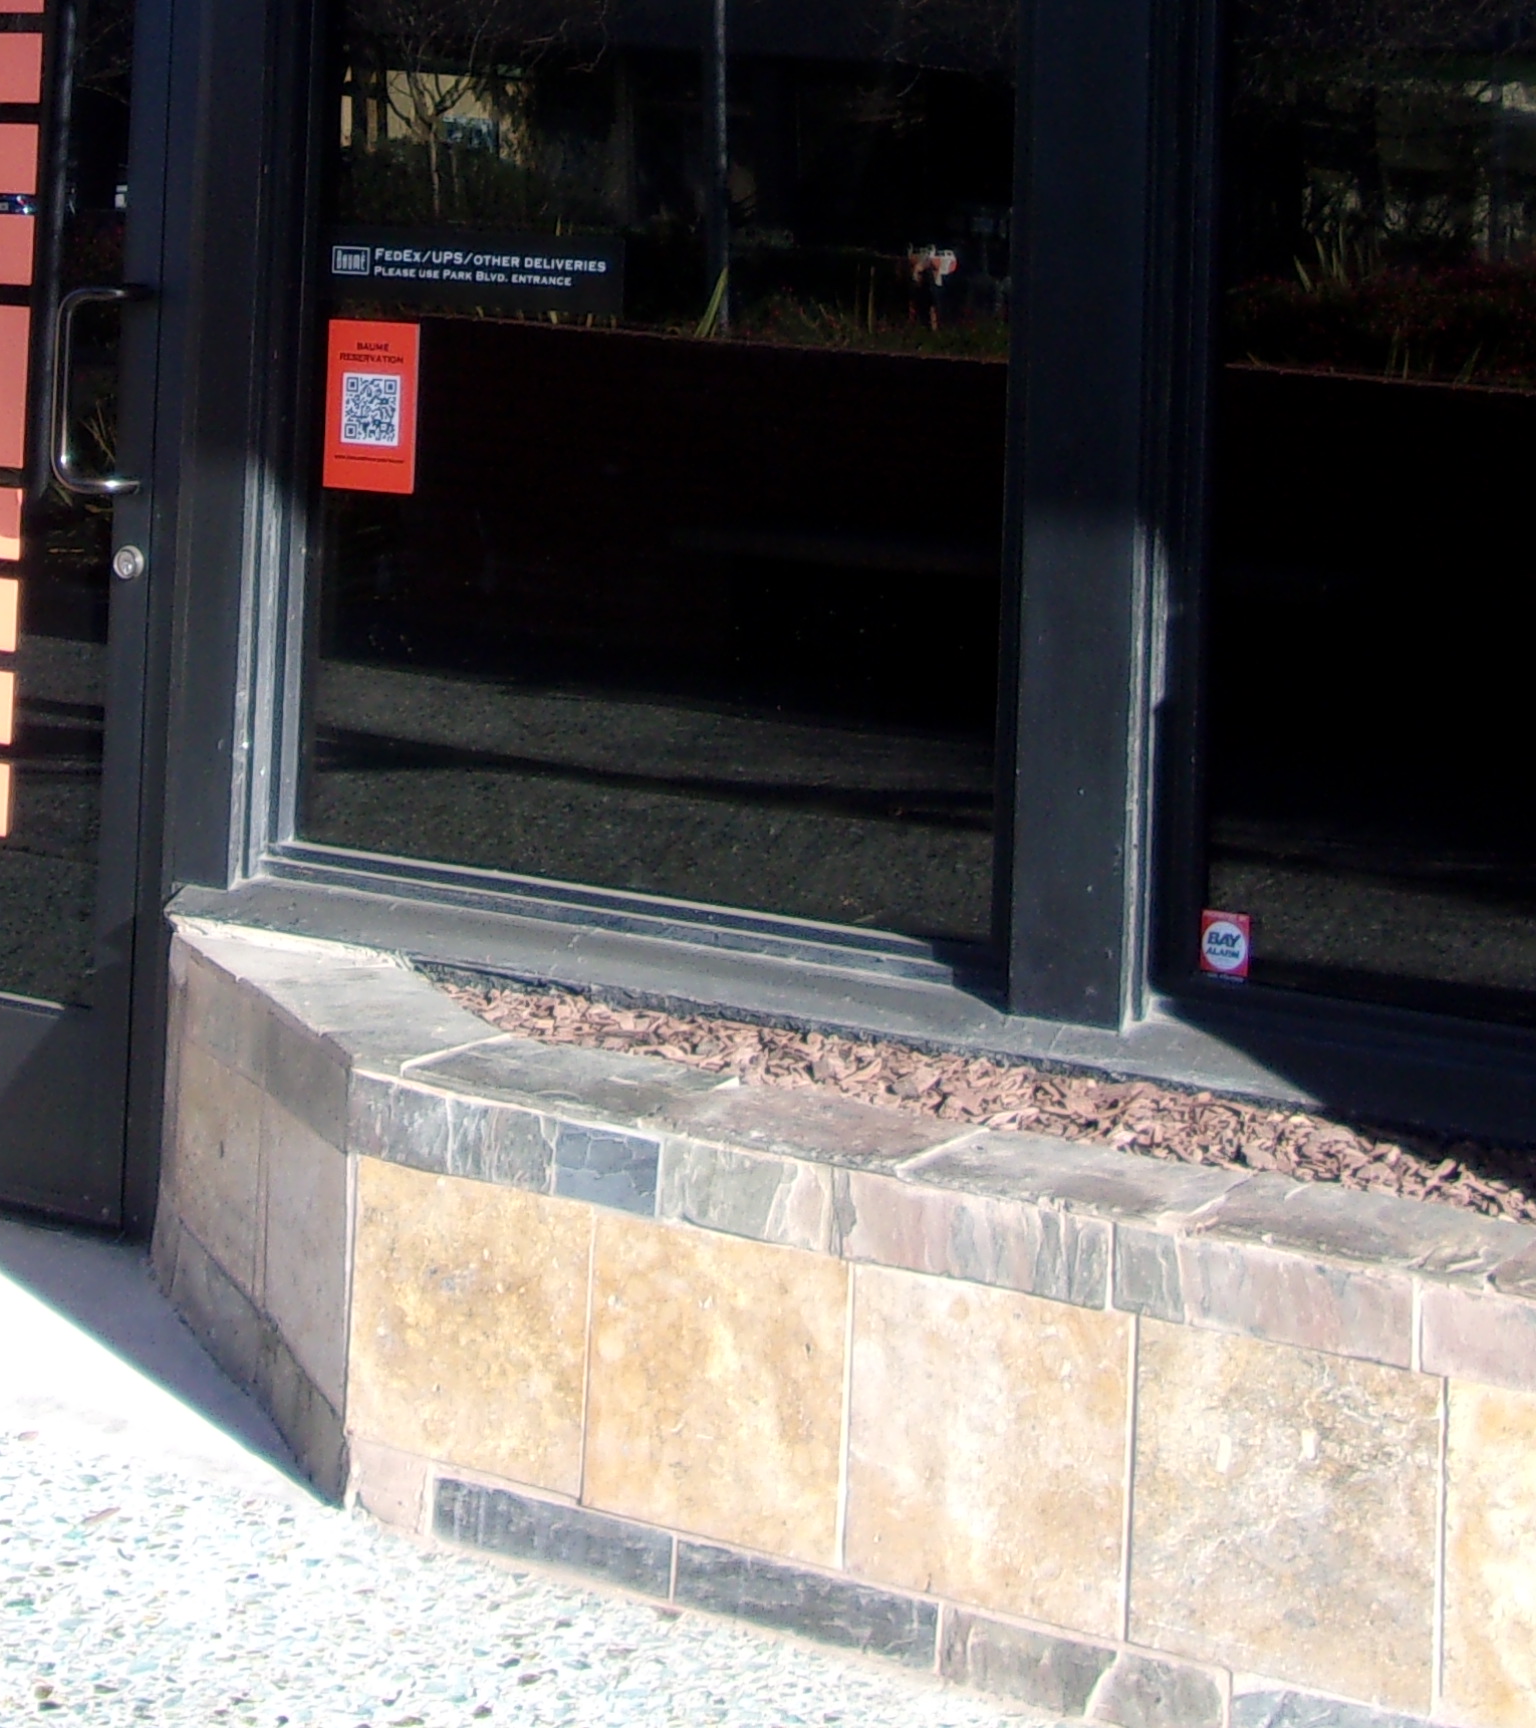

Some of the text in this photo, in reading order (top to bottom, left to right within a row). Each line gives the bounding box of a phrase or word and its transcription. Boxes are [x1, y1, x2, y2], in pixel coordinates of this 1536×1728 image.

[524, 256, 607, 273] DELIVERIES
[374, 265, 573, 287] PLEASE USE PARK BLVD. ENTRANCE
[339, 352, 404, 364] RESERVATION
[1207, 931, 1241, 948] BAY
